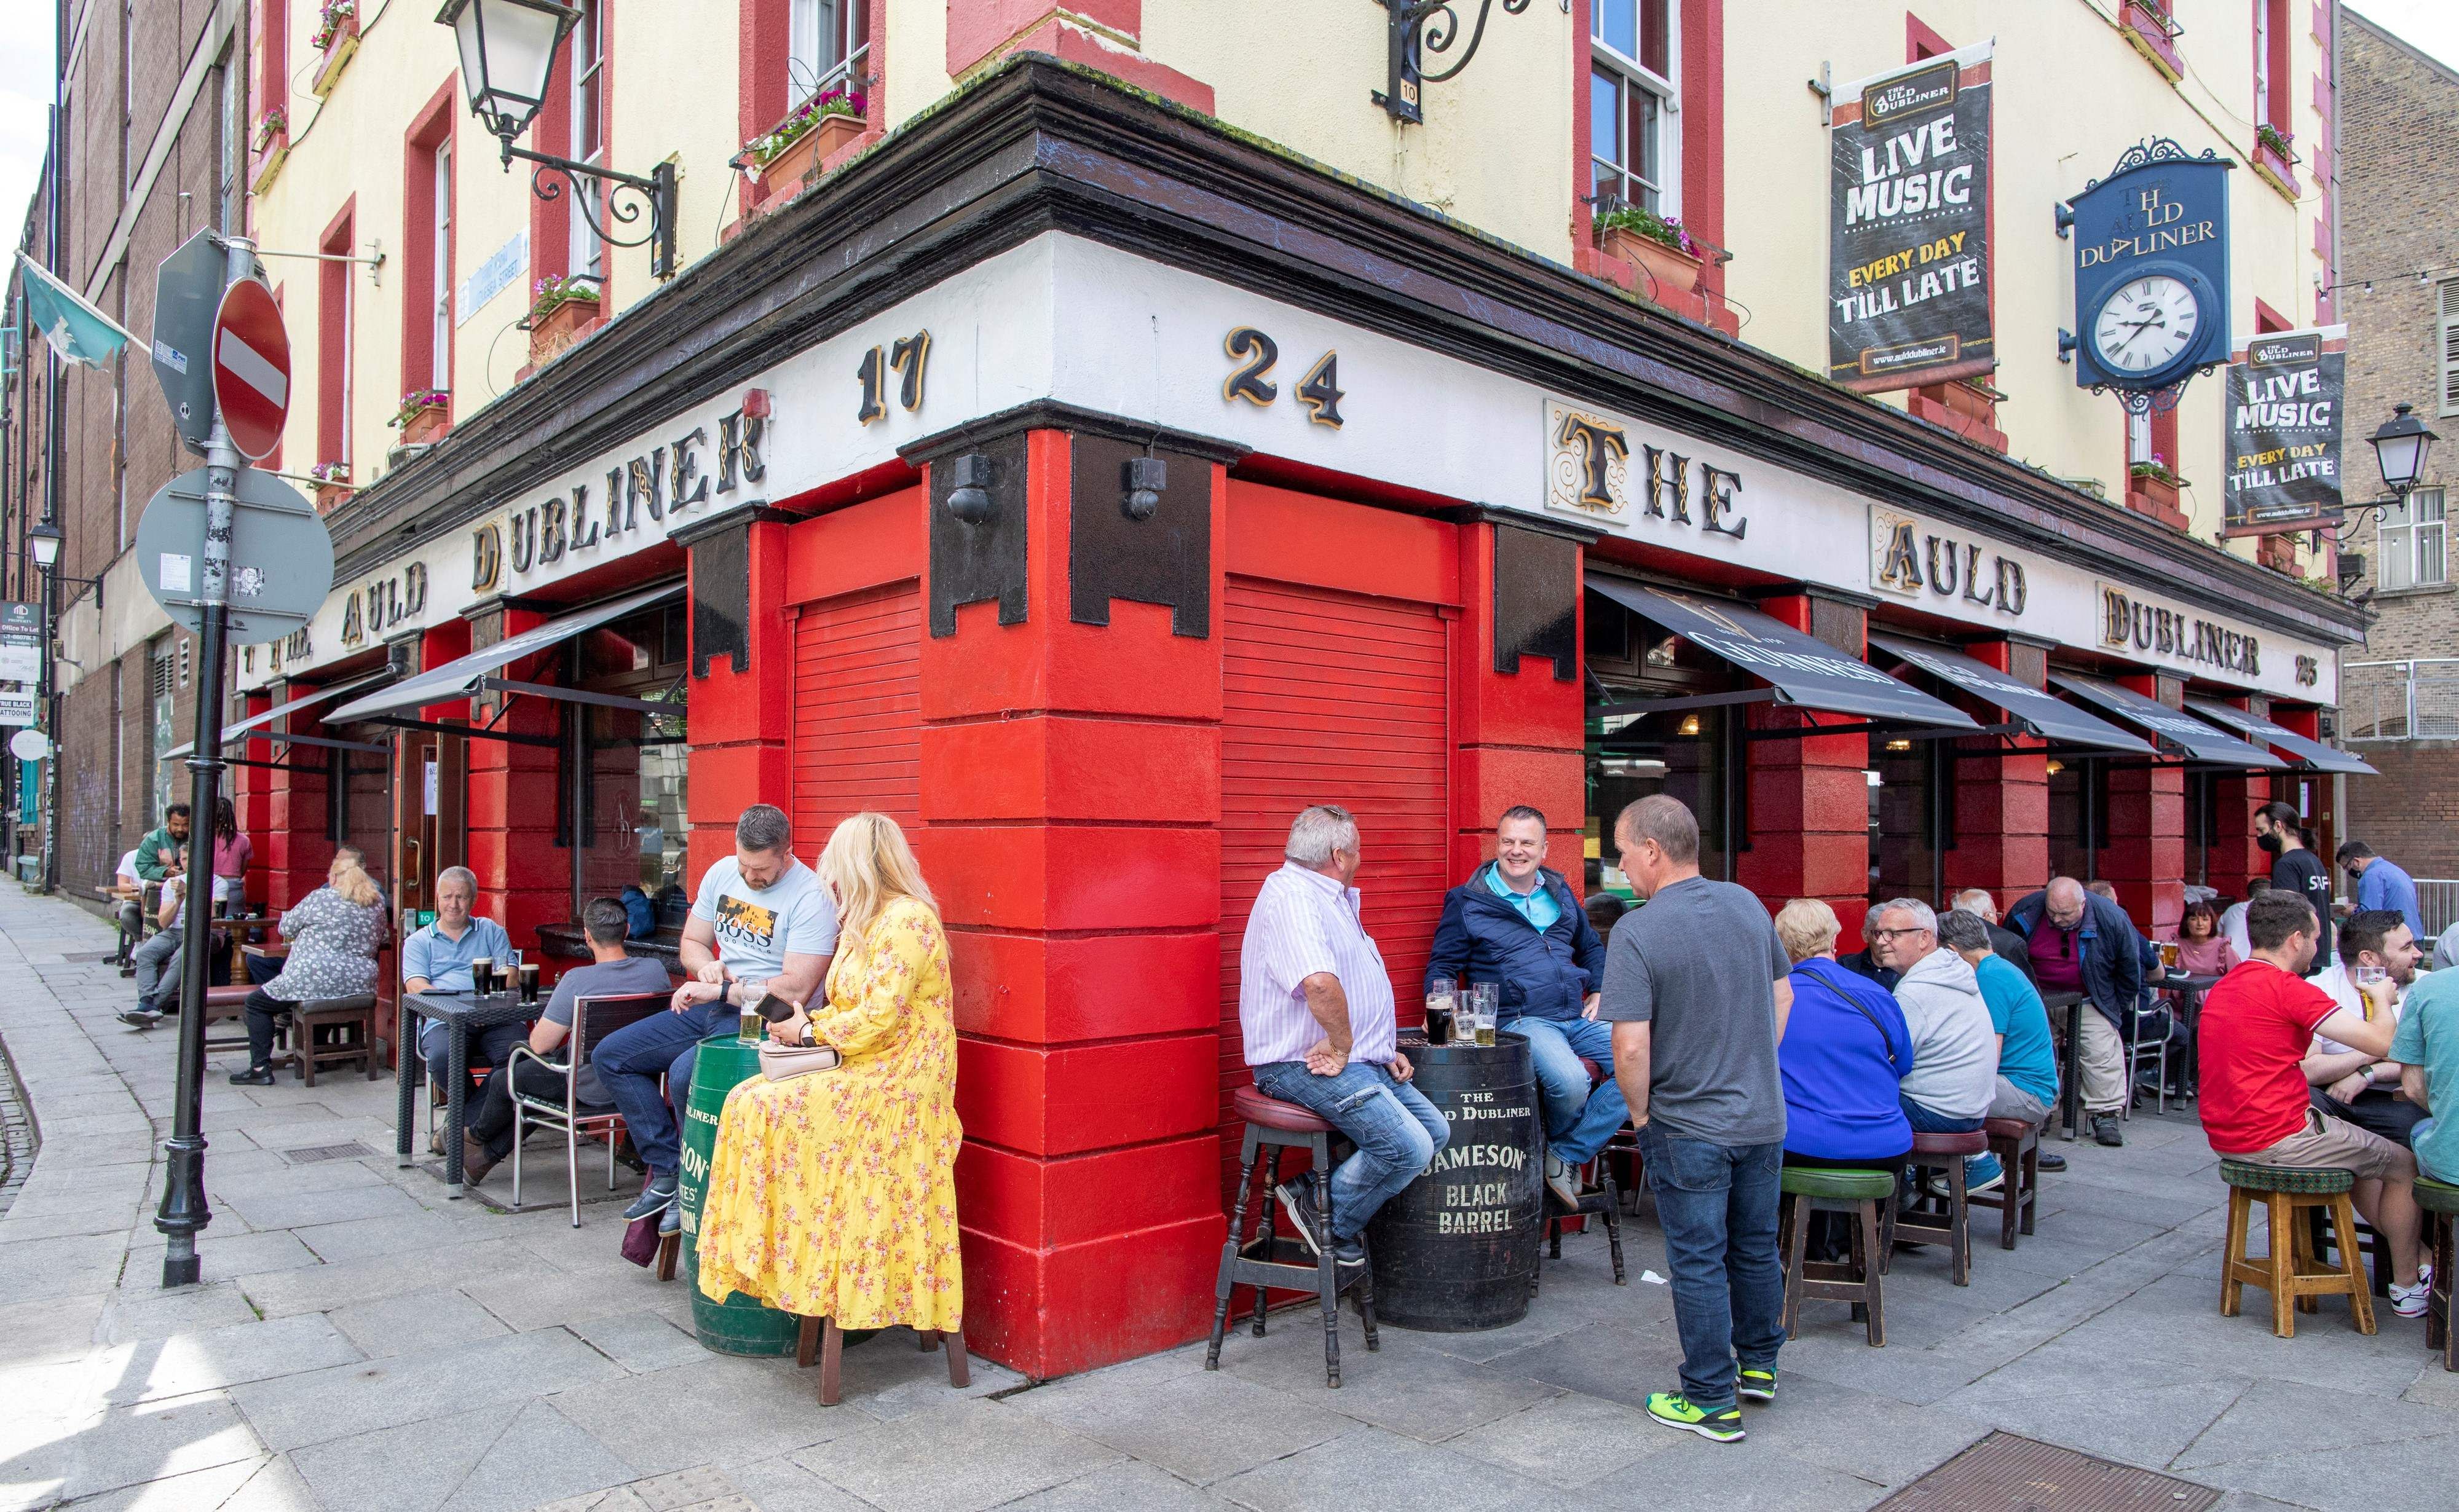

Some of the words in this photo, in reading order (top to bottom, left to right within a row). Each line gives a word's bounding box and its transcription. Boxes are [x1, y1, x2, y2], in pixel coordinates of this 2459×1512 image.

[1403, 84, 1415, 100] 10
[1874, 88, 1916, 106] AULD
[1877, 87, 1949, 114] DUBLINER
[1887, 85, 1905, 95] THE
[1861, 113, 1957, 184] LIVE
[1846, 164, 1973, 226] MUSIC
[1849, 248, 1913, 288] EVERY
[1919, 231, 1966, 263] DAY
[1901, 258, 1980, 307] LATE
[1873, 345, 1946, 364] www.aulddubliner.ie
[2257, 347, 2288, 356] AULD
[2260, 350, 2314, 361] DUBLINER
[858, 328, 930, 427] 17
[1223, 325, 1346, 430] 24
[2246, 368, 2321, 405] LIVE
[2235, 401, 2331, 429] MUSIC
[2238, 447, 2286, 470] EVERY
[2290, 443, 2326, 459] DAY
[2279, 460, 2334, 484] LATE
[341, 561, 427, 645] AULD
[472, 408, 765, 594] DUBLINER
[1561, 412, 1747, 540] THE
[1881, 519, 2026, 615] AULD
[2105, 586, 2261, 677] DUBLINER
[1687, 631, 1895, 685] GUINNESS
[2296, 654, 2318, 687] 25
[715, 911, 771, 947] BOSS
[1460, 1093, 1494, 1103] THE
[1462, 1106, 1531, 1120] DUBLINER
[1446, 1182, 1507, 1207] BLACK
[1439, 1209, 1513, 1234] BARREL
